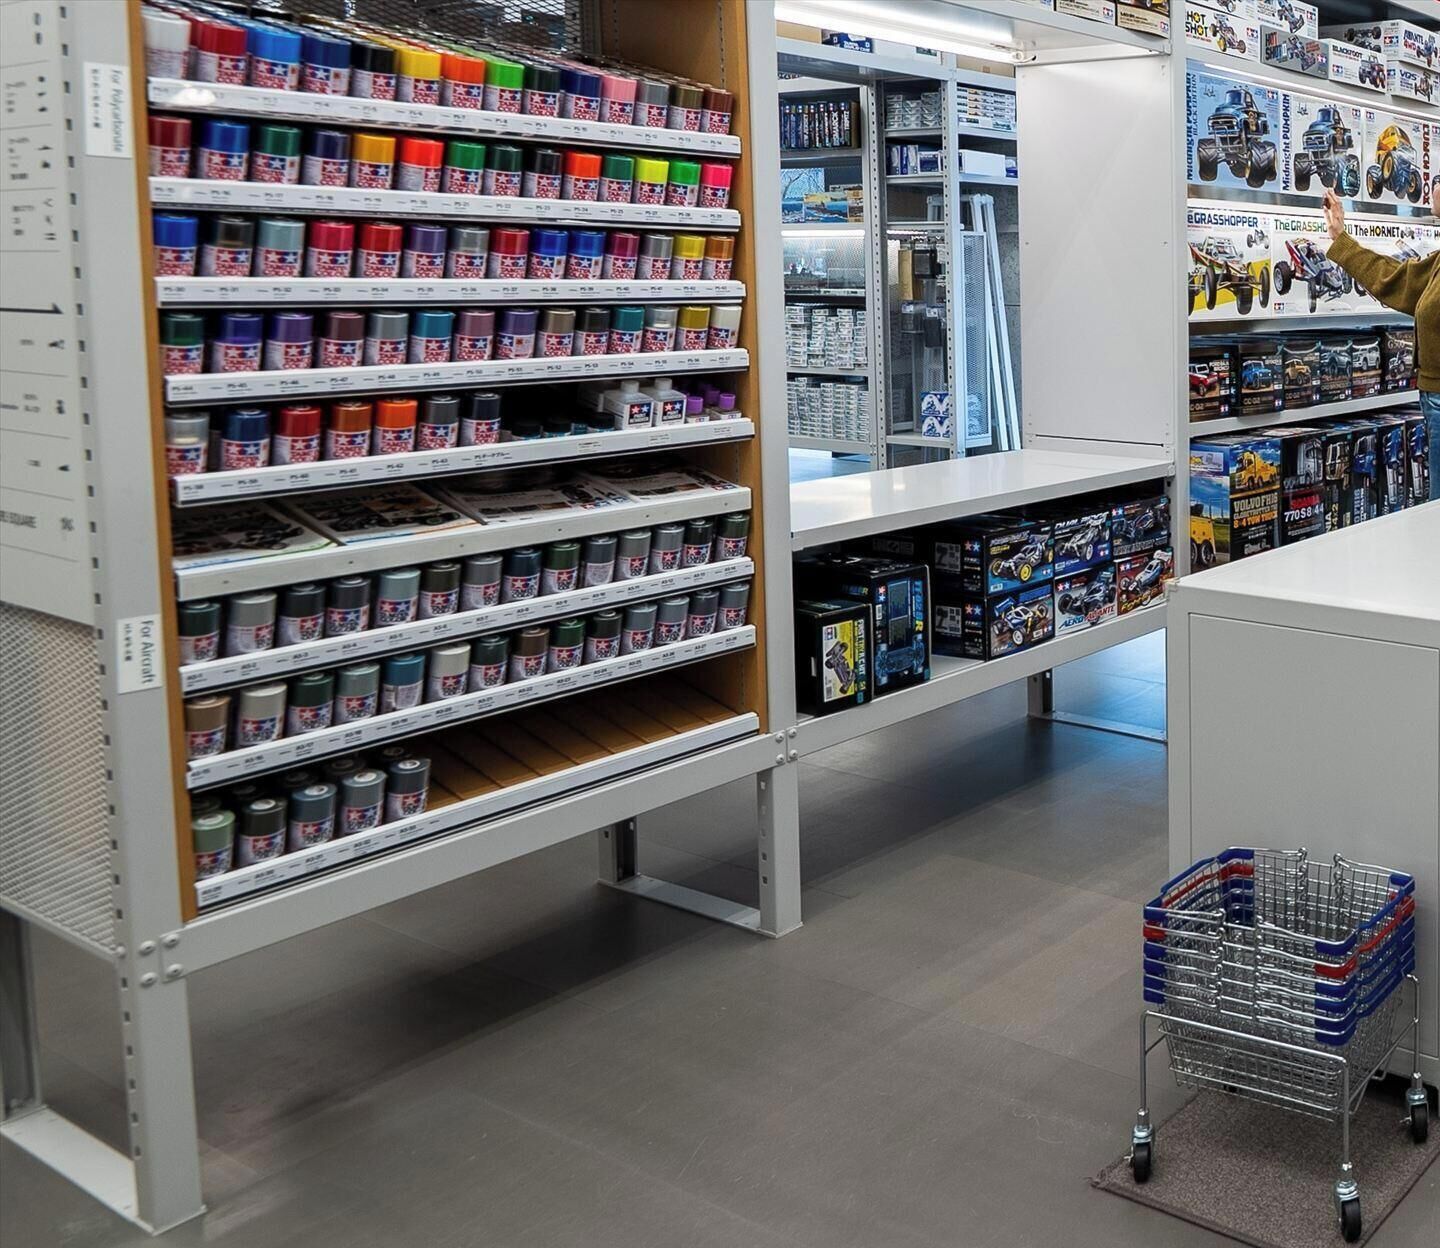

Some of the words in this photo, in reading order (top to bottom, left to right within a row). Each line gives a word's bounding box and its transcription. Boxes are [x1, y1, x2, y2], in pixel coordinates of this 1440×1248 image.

[1186, 10, 1206, 25] HOT
[1185, 21, 1208, 38] SHOT
[1332, 44, 1363, 59] BLACKFOOT
[1282, 94, 1290, 140] PUMPKIN
[1282, 141, 1291, 191] Midnight
[1194, 212, 1258, 228] GRASSHOPPER
[1274, 218, 1291, 231] The
[1354, 224, 1369, 237] The
[1369, 225, 1400, 238] HORNET
[1233, 495, 1261, 512] VOLVO
[1055, 519, 1078, 530] DUAL
[1058, 615, 1084, 630] AERO
[1084, 604, 1116, 622] AVANTE
[140, 620, 155, 638] For
[141, 641, 156, 685] Aircraft
